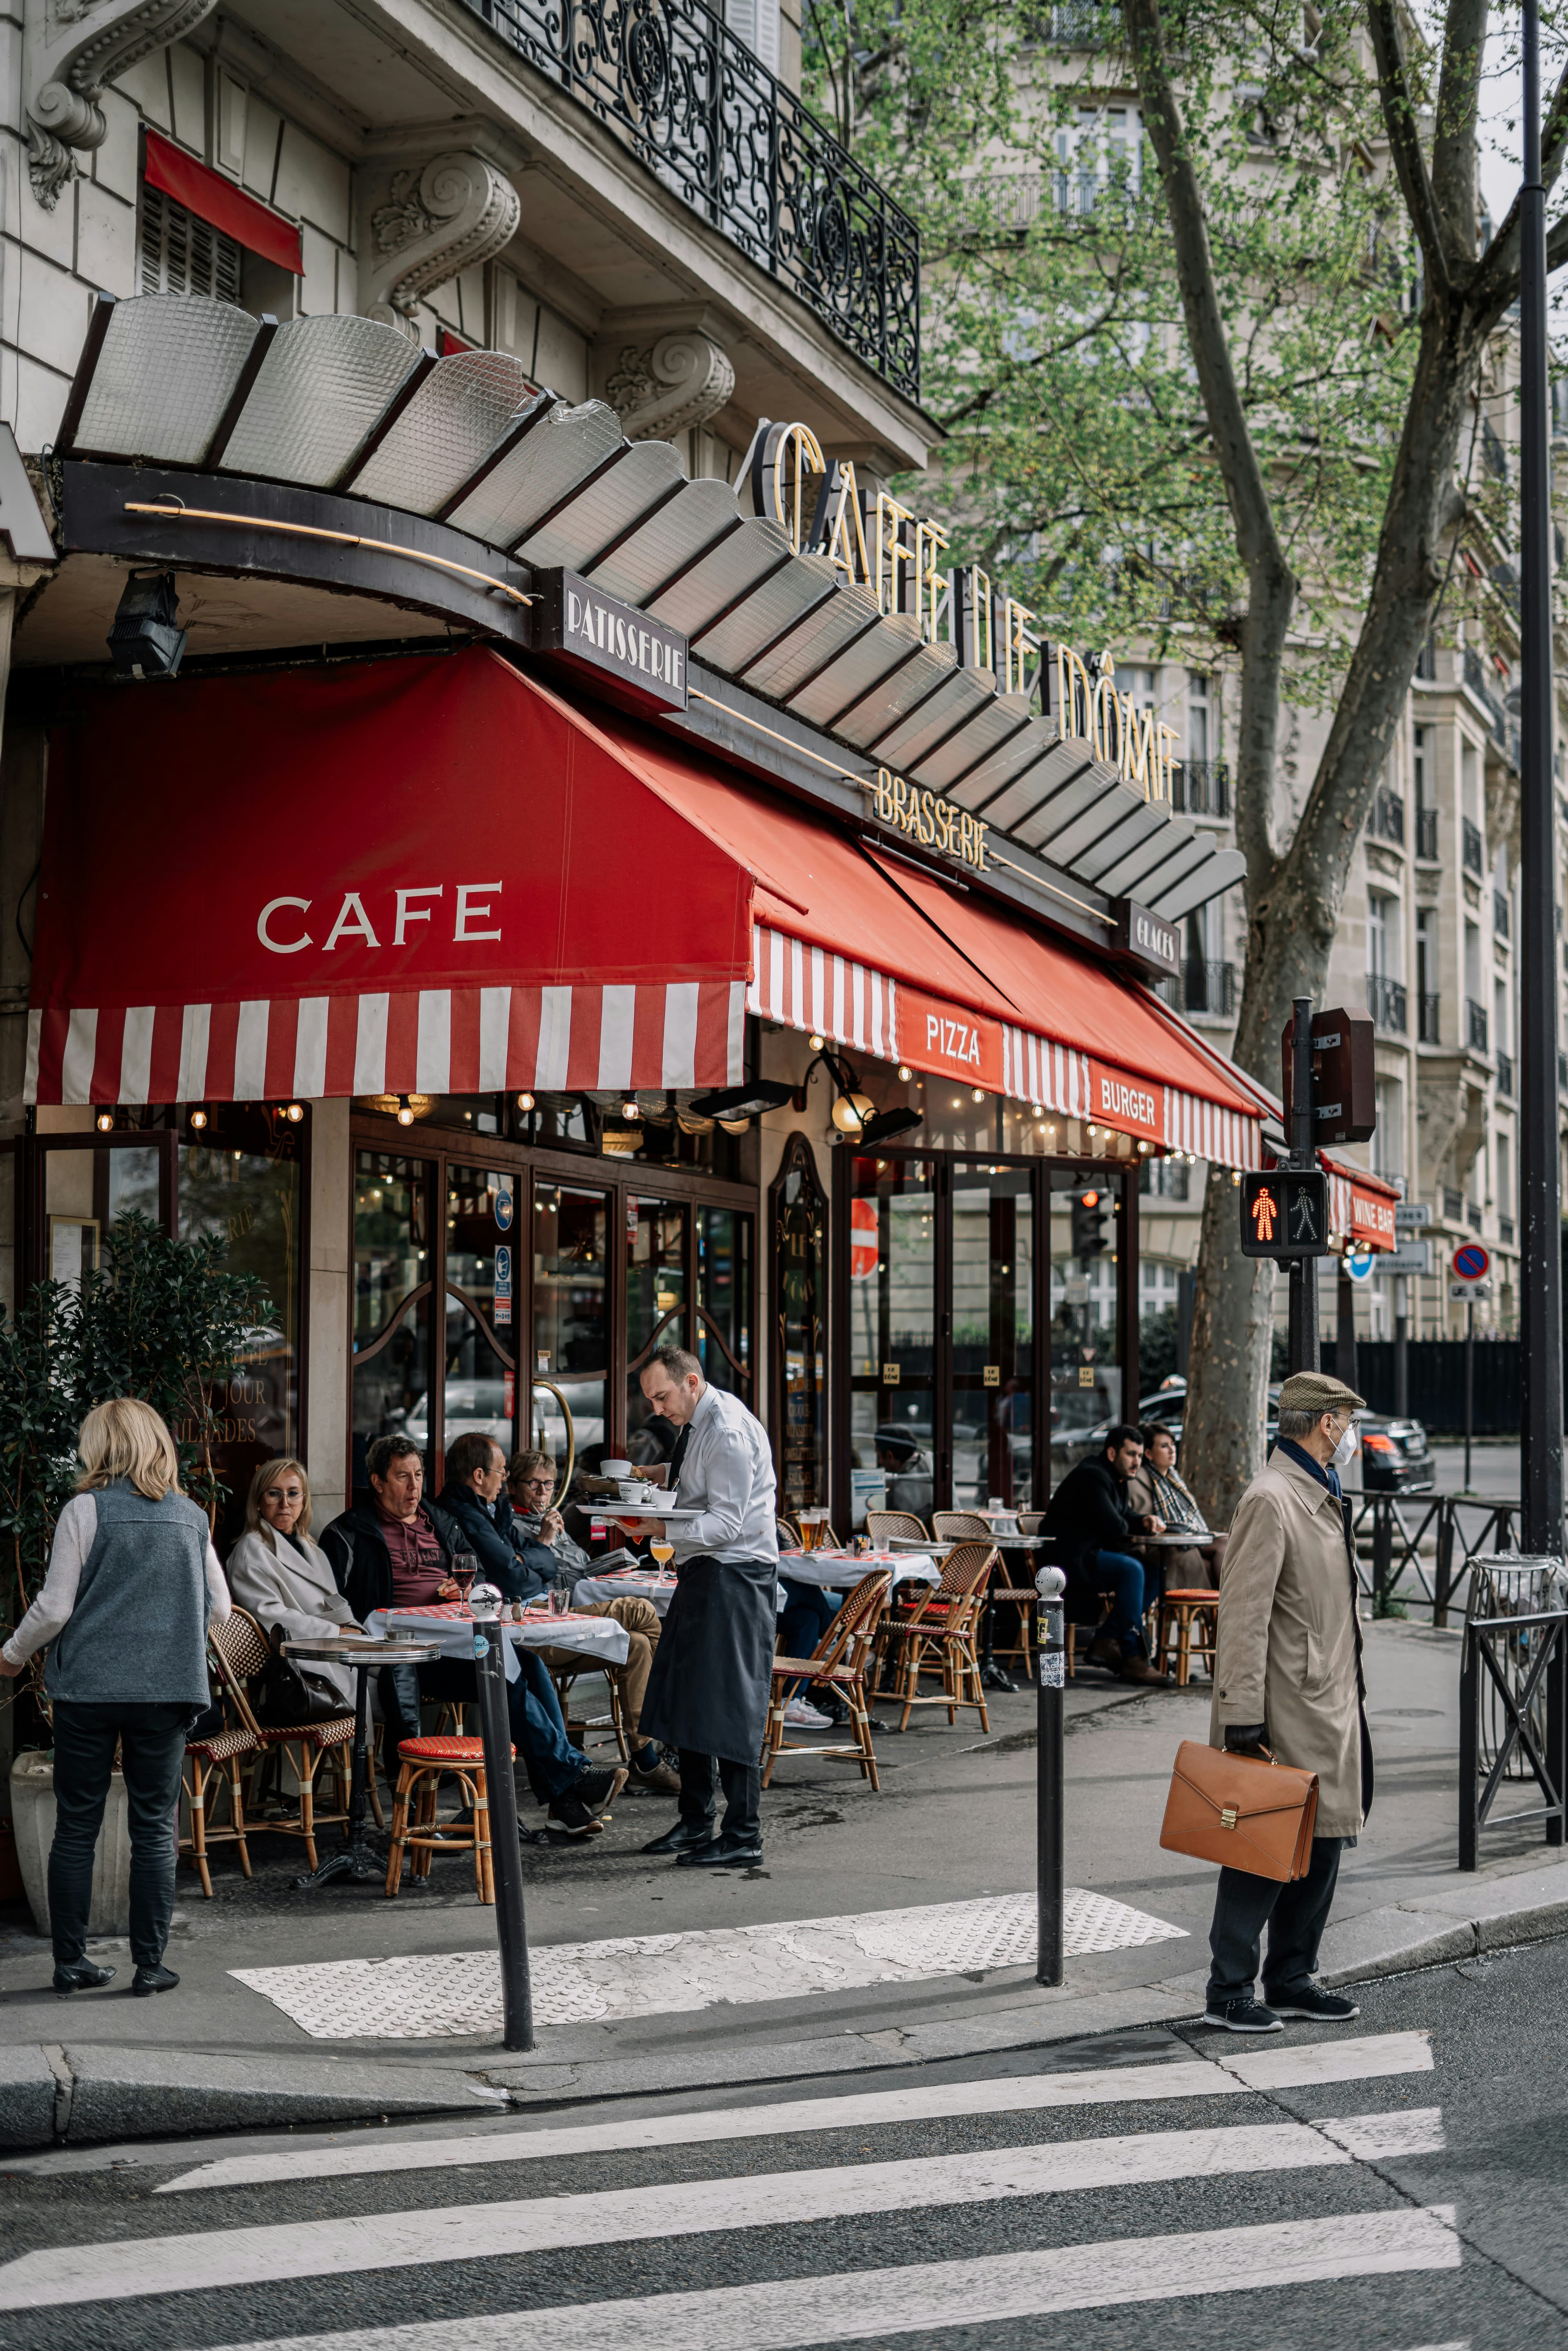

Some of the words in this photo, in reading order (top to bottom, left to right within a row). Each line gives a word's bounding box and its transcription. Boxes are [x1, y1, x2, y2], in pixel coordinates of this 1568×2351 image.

[567, 588, 683, 691] PATISSERIE
[876, 767, 991, 872] BRASSERIE
[257, 880, 503, 954] CAFE
[1136, 916, 1175, 963] GLACES
[926, 1013, 980, 1066] PIZZA
[1101, 1078, 1156, 1127] BURGER
[1352, 1196, 1377, 1230] WINE
[1376, 1205, 1394, 1235] BAR
[221, 1379, 267, 1410] JOUR
[421, 1549, 440, 1561] EASY
